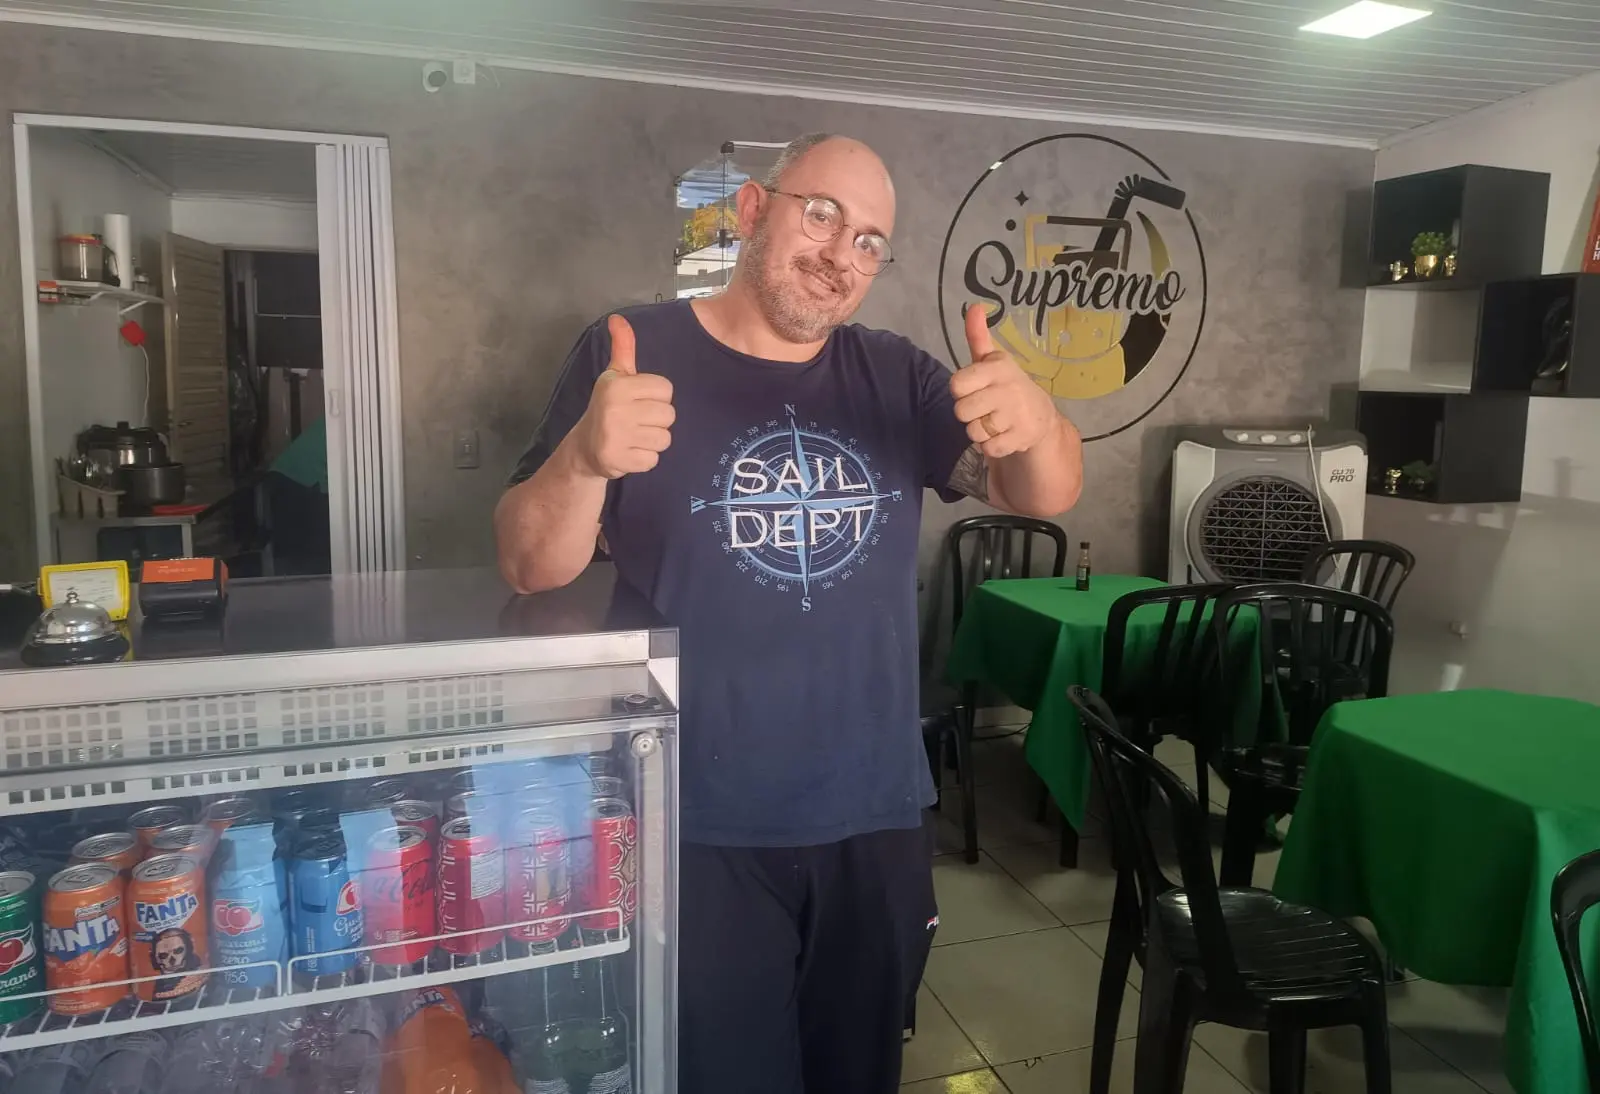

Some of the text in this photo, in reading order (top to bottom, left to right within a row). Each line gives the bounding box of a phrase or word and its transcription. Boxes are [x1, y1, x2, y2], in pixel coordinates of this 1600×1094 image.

[961, 240, 1187, 337] Supremo
[784, 403, 797, 416] N
[733, 456, 868, 495] SAIL
[1329, 475, 1354, 483] PRO
[890, 489, 904, 502] E
[730, 505, 875, 548] DEPT
[754, 574, 769, 587] 210
[801, 596, 812, 613] S
[135, 892, 197, 924] FANTA
[399, 989, 445, 1021] ANTA
